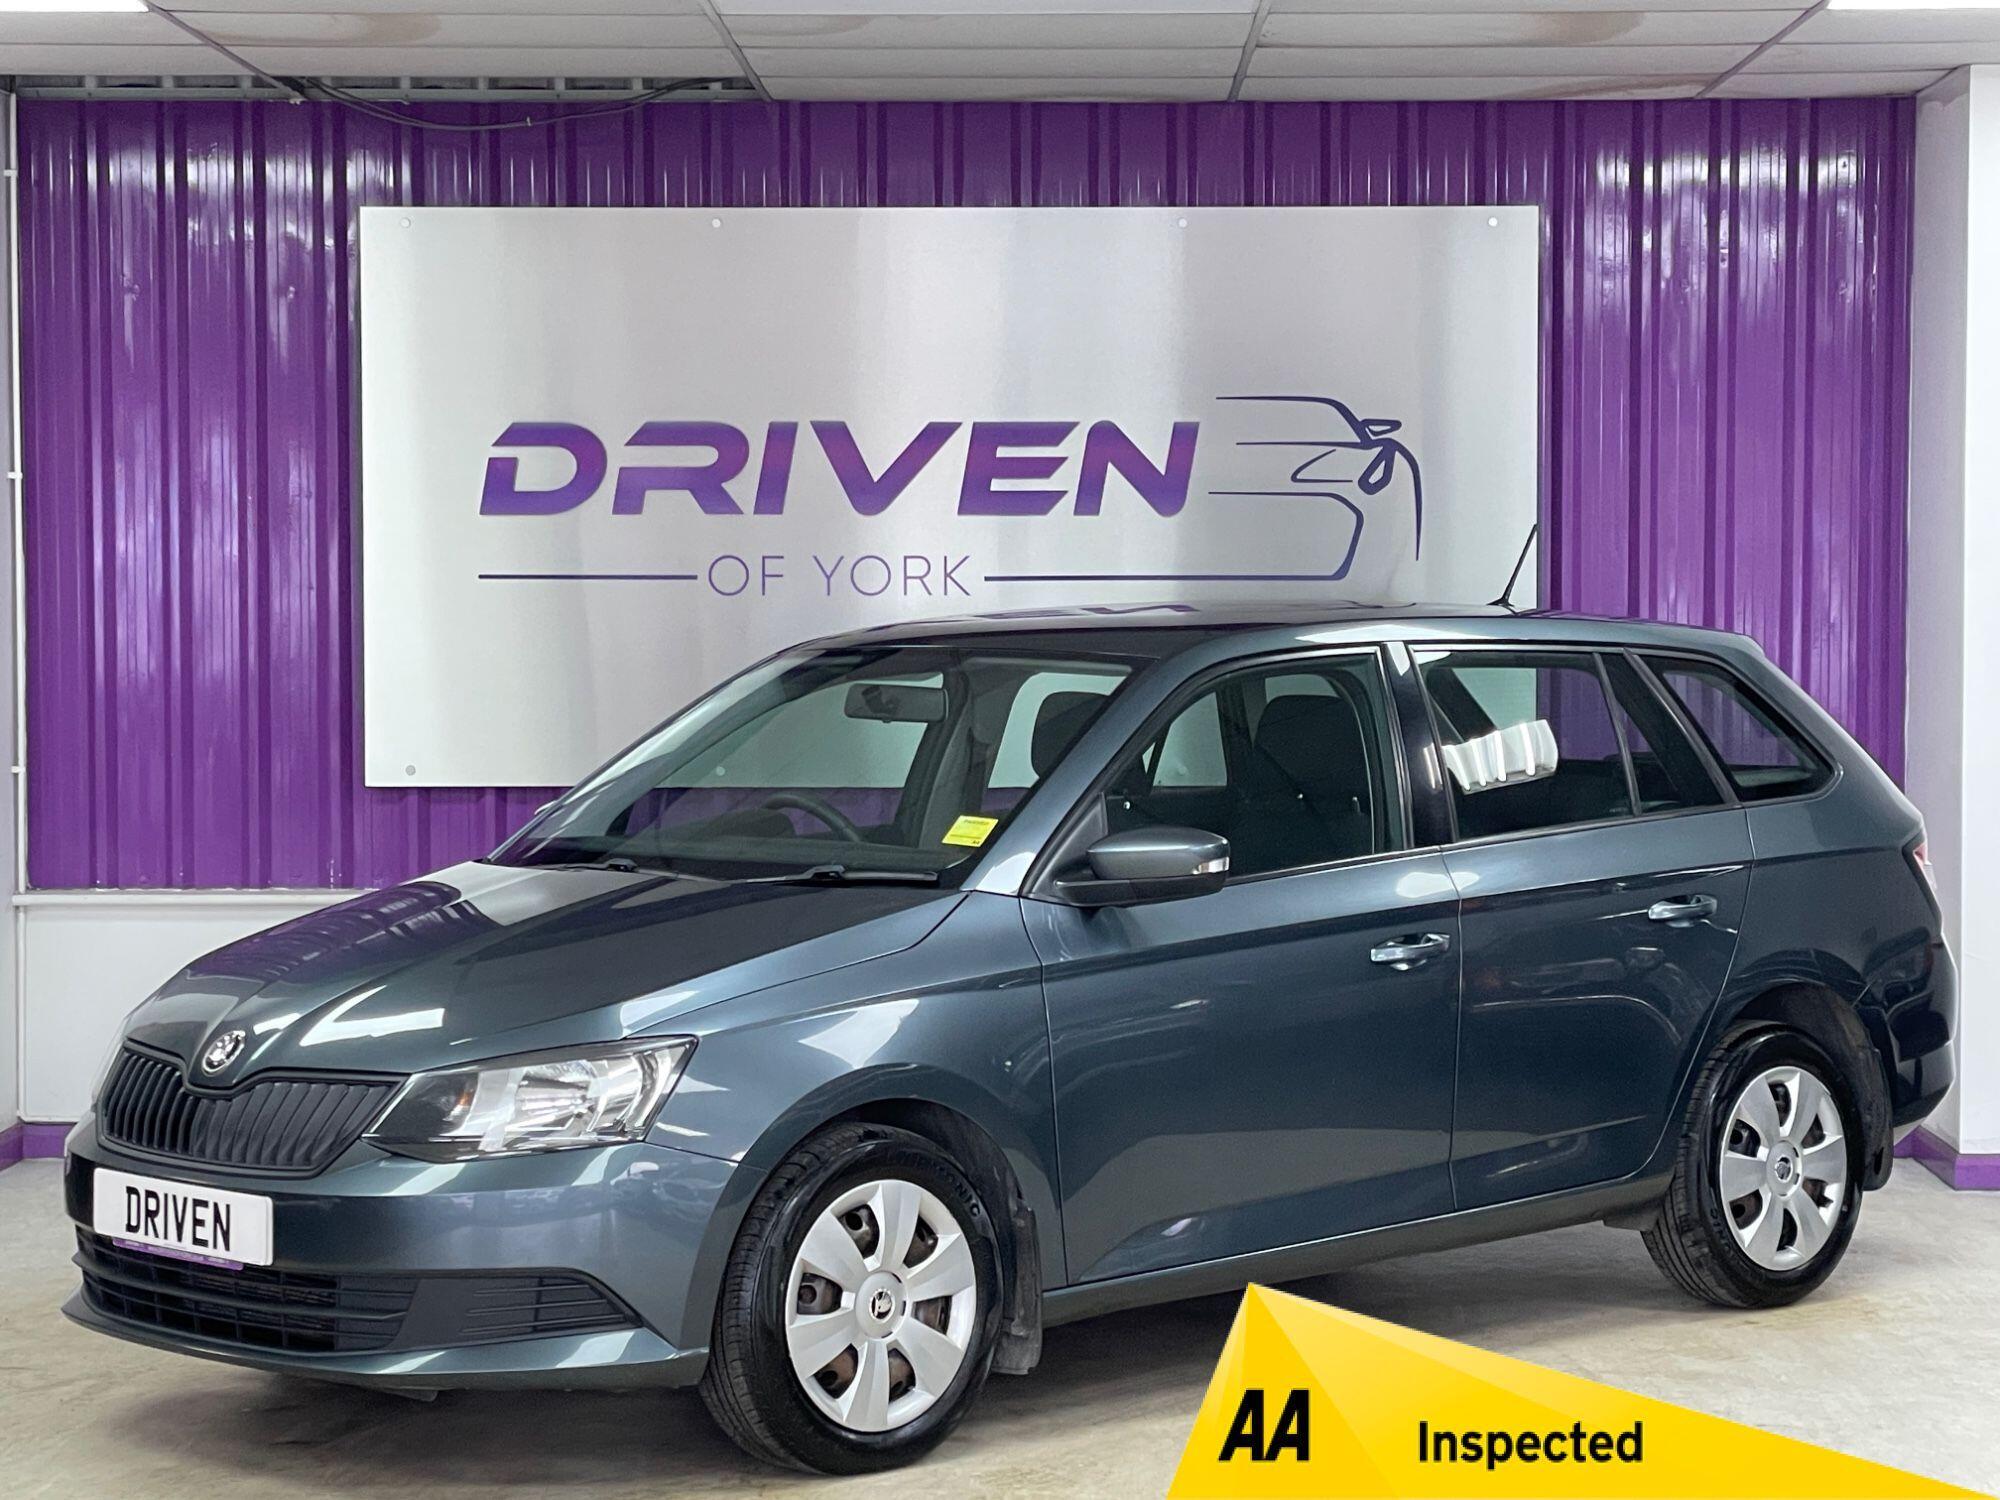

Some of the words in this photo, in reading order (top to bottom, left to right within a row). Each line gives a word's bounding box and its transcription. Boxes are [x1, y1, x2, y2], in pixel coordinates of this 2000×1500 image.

[480, 420, 1199, 516] DRIVEN
[708, 555, 785, 597] OF
[812, 555, 971, 597] YORK
[125, 1186, 231, 1252] DRIVEN
